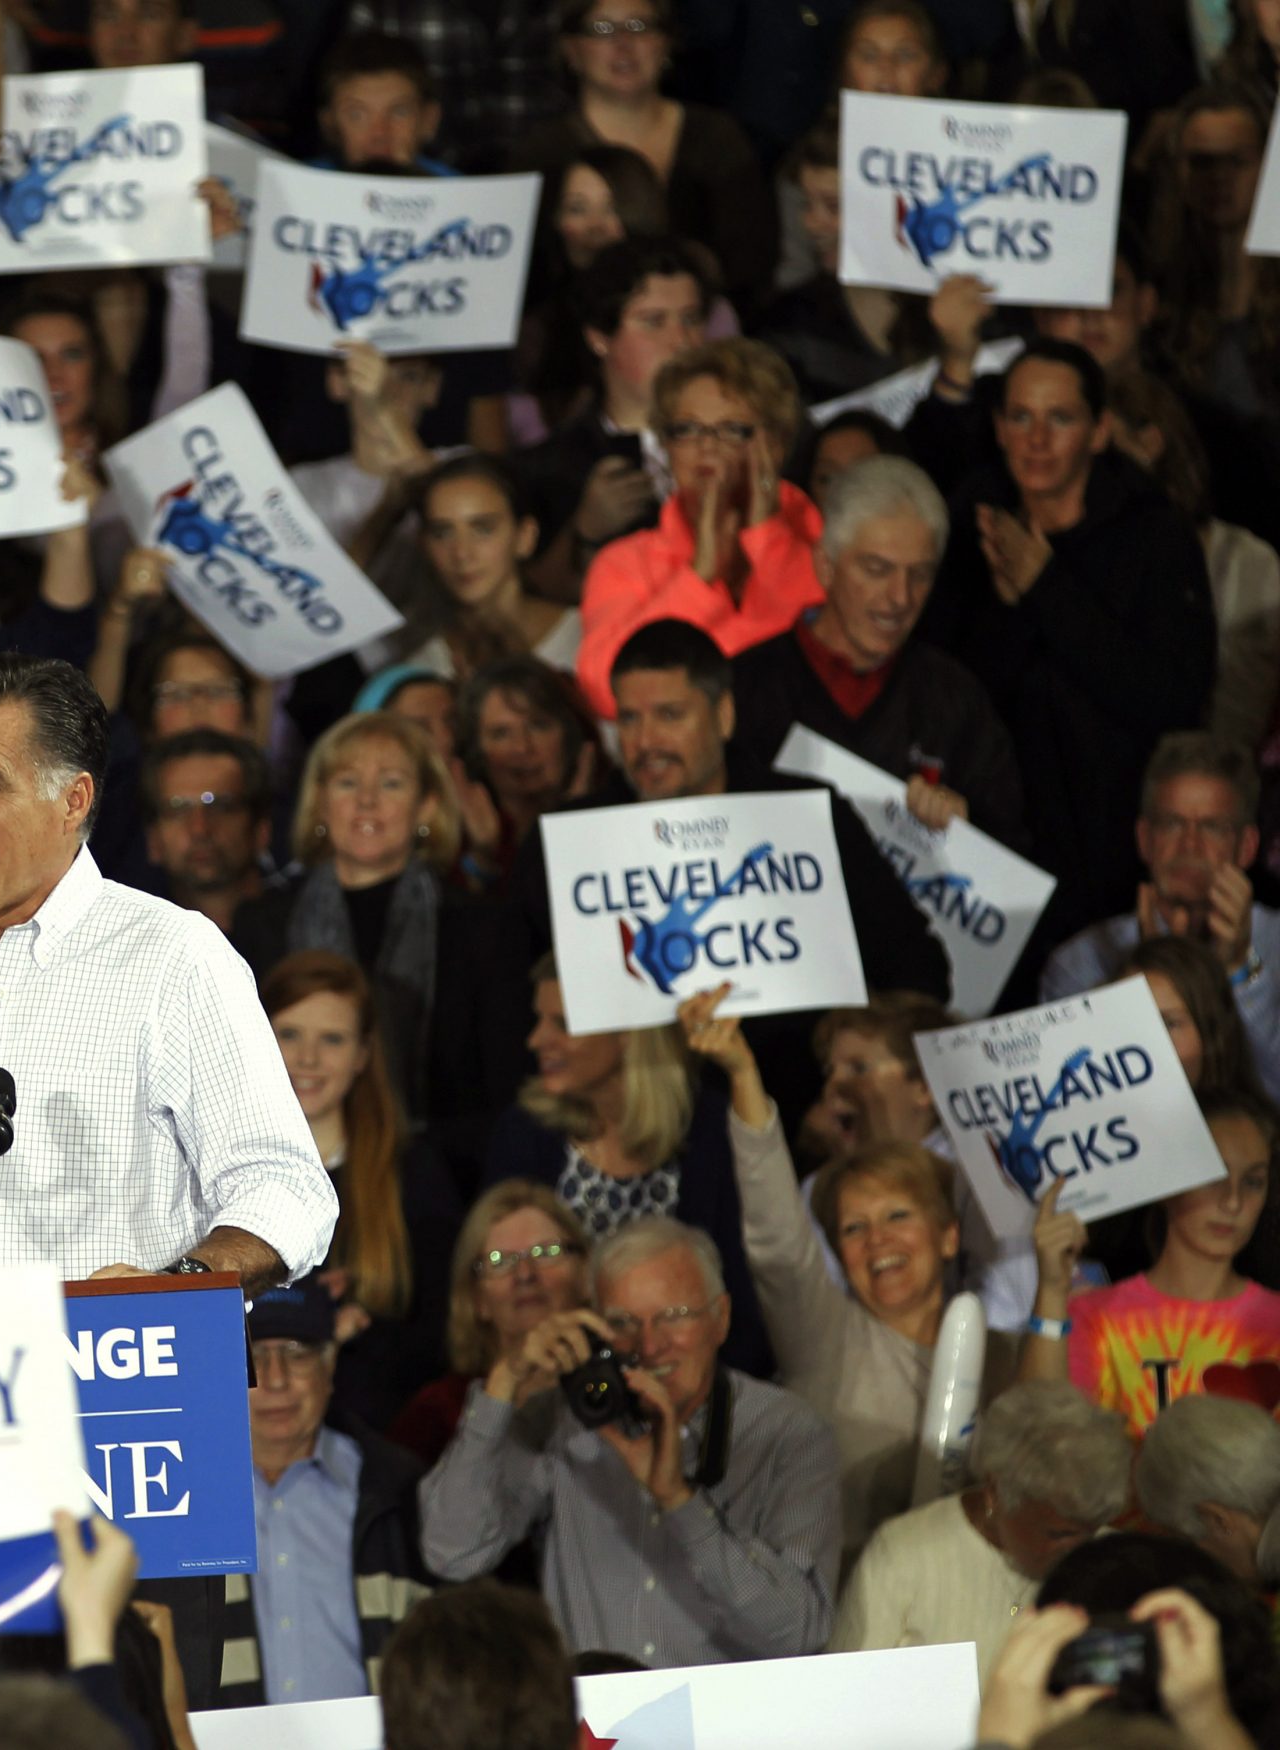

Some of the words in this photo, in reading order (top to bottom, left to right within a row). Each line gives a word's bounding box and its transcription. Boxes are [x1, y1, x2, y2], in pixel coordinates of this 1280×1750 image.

[859, 146, 1099, 204] CLEVELAND
[272, 215, 513, 261] CLEVELAND
[895, 192, 1054, 268] ROCKS
[307, 264, 467, 330] ROCKS
[182, 425, 344, 636] CLEVELAND
[573, 853, 823, 915] CLEVELAND
[617, 914, 802, 995] ROCKS
[948, 1044, 1154, 1130] CLEVELAND
[986, 1116, 1140, 1203] ROCKS
